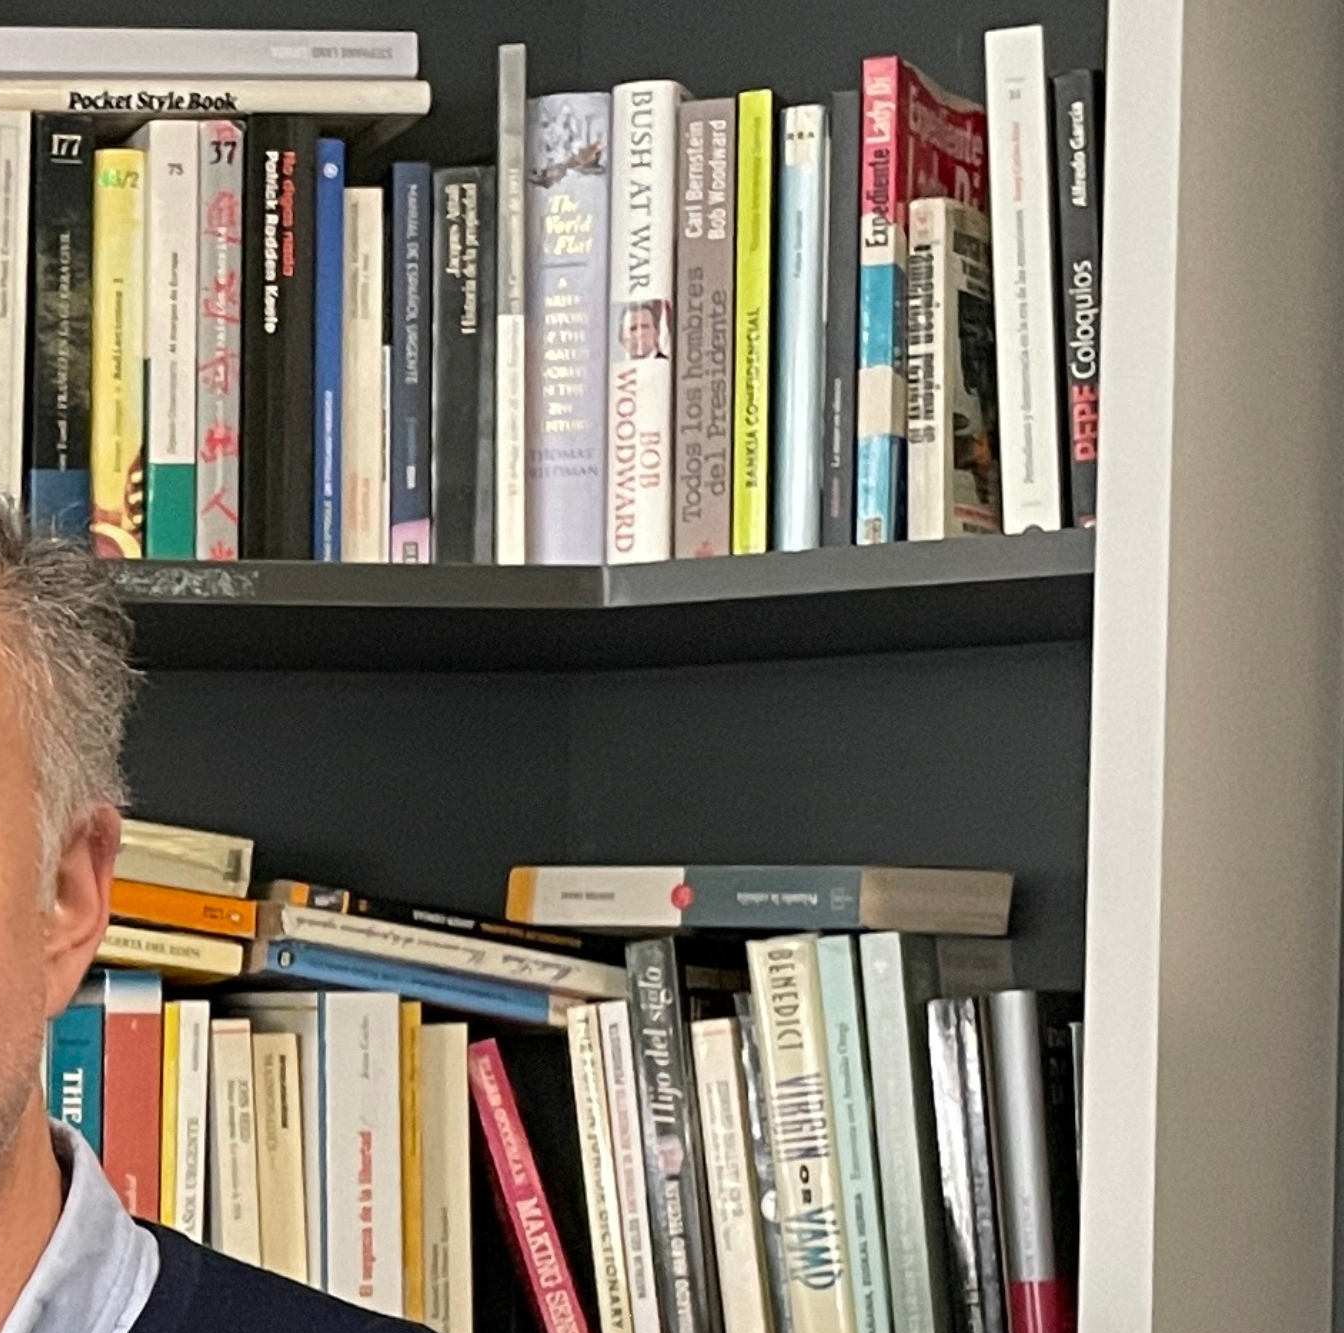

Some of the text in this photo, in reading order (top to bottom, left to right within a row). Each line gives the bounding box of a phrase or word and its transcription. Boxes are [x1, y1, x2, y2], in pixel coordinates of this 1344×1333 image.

[49, 133, 82, 157] 177
[67, 90, 238, 112] Pocket Style Book
[209, 140, 237, 165] 37
[627, 90, 653, 294] BUSH AT WAR
[684, 120, 706, 238] Carl Bernstein
[707, 118, 728, 240] Bob Woodward
[864, 76, 894, 247] Expediente Lady Di
[680, 265, 705, 523] Todos los hombres
[704, 289, 729, 497] del Presidente
[612, 367, 637, 554] WOODWARD
[637, 429, 660, 489] BOB
[744, 430, 761, 488] BANKIA
[637, 965, 682, 1125] Hijo del siglo
[766, 948, 804, 1051] BENEDICT
[62, 1067, 84, 1123] THE
[769, 1072, 831, 1163] VIRGIN
[783, 1205, 846, 1292] VAMP
